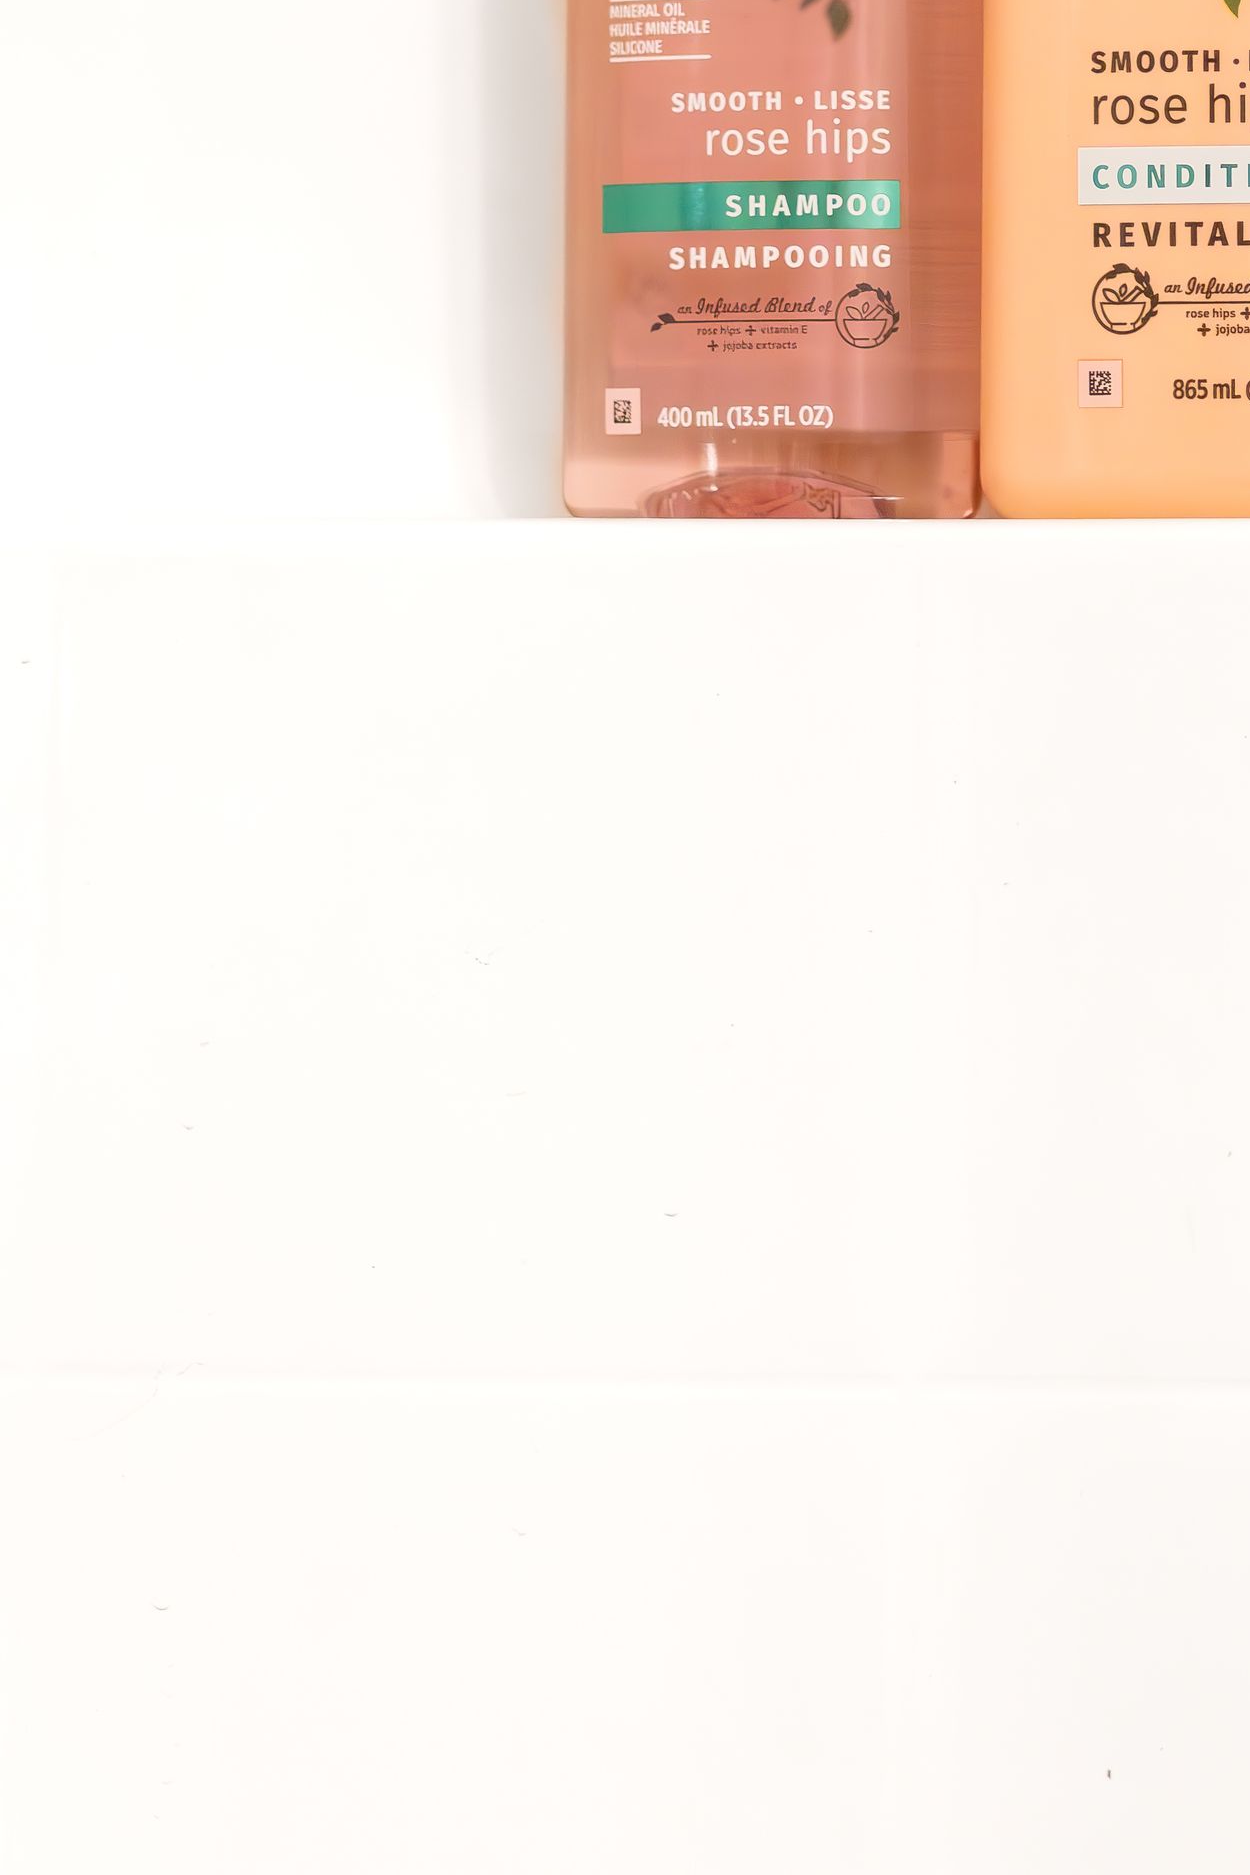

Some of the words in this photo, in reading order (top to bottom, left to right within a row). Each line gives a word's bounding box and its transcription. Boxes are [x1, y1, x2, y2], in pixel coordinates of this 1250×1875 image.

[609, 4, 660, 18] MINERAL
[663, 3, 685, 16] OIL
[609, 22, 643, 37] HUILE
[645, 17, 711, 35] MINÉRALE
[609, 40, 663, 55] SILICONE
[1090, 49, 1221, 73] SMOOTH
[671, 91, 782, 113] SMOOTH
[814, 90, 891, 110] LISSE
[1093, 94, 1188, 125] rose
[706, 128, 789, 156] rose
[806, 117, 891, 163] hips
[725, 194, 891, 217] SHAMPOO
[668, 245, 892, 270] SHAMPOOING
[1164, 284, 1182, 293] an
[677, 306, 692, 315] an
[695, 297, 761, 318] Infused
[764, 296, 816, 314] Blend
[818, 300, 833, 315] of
[1185, 310, 1210, 319] rose
[1212, 308, 1236, 320] hips
[697, 328, 719, 336] rose
[720, 325, 741, 337] hips
[760, 325, 799, 334] vitamin
[801, 325, 808, 334] E
[1215, 324, 1250, 337] jojoba
[722, 340, 754, 352] jojoba
[756, 340, 798, 351] extracts
[1172, 379, 1209, 400] 865
[1212, 379, 1241, 399] mL
[657, 407, 692, 427] 400
[696, 407, 723, 427] mL
[727, 406, 769, 429] (13.5
[774, 406, 795, 426] FL
[799, 405, 834, 428] OZ)
